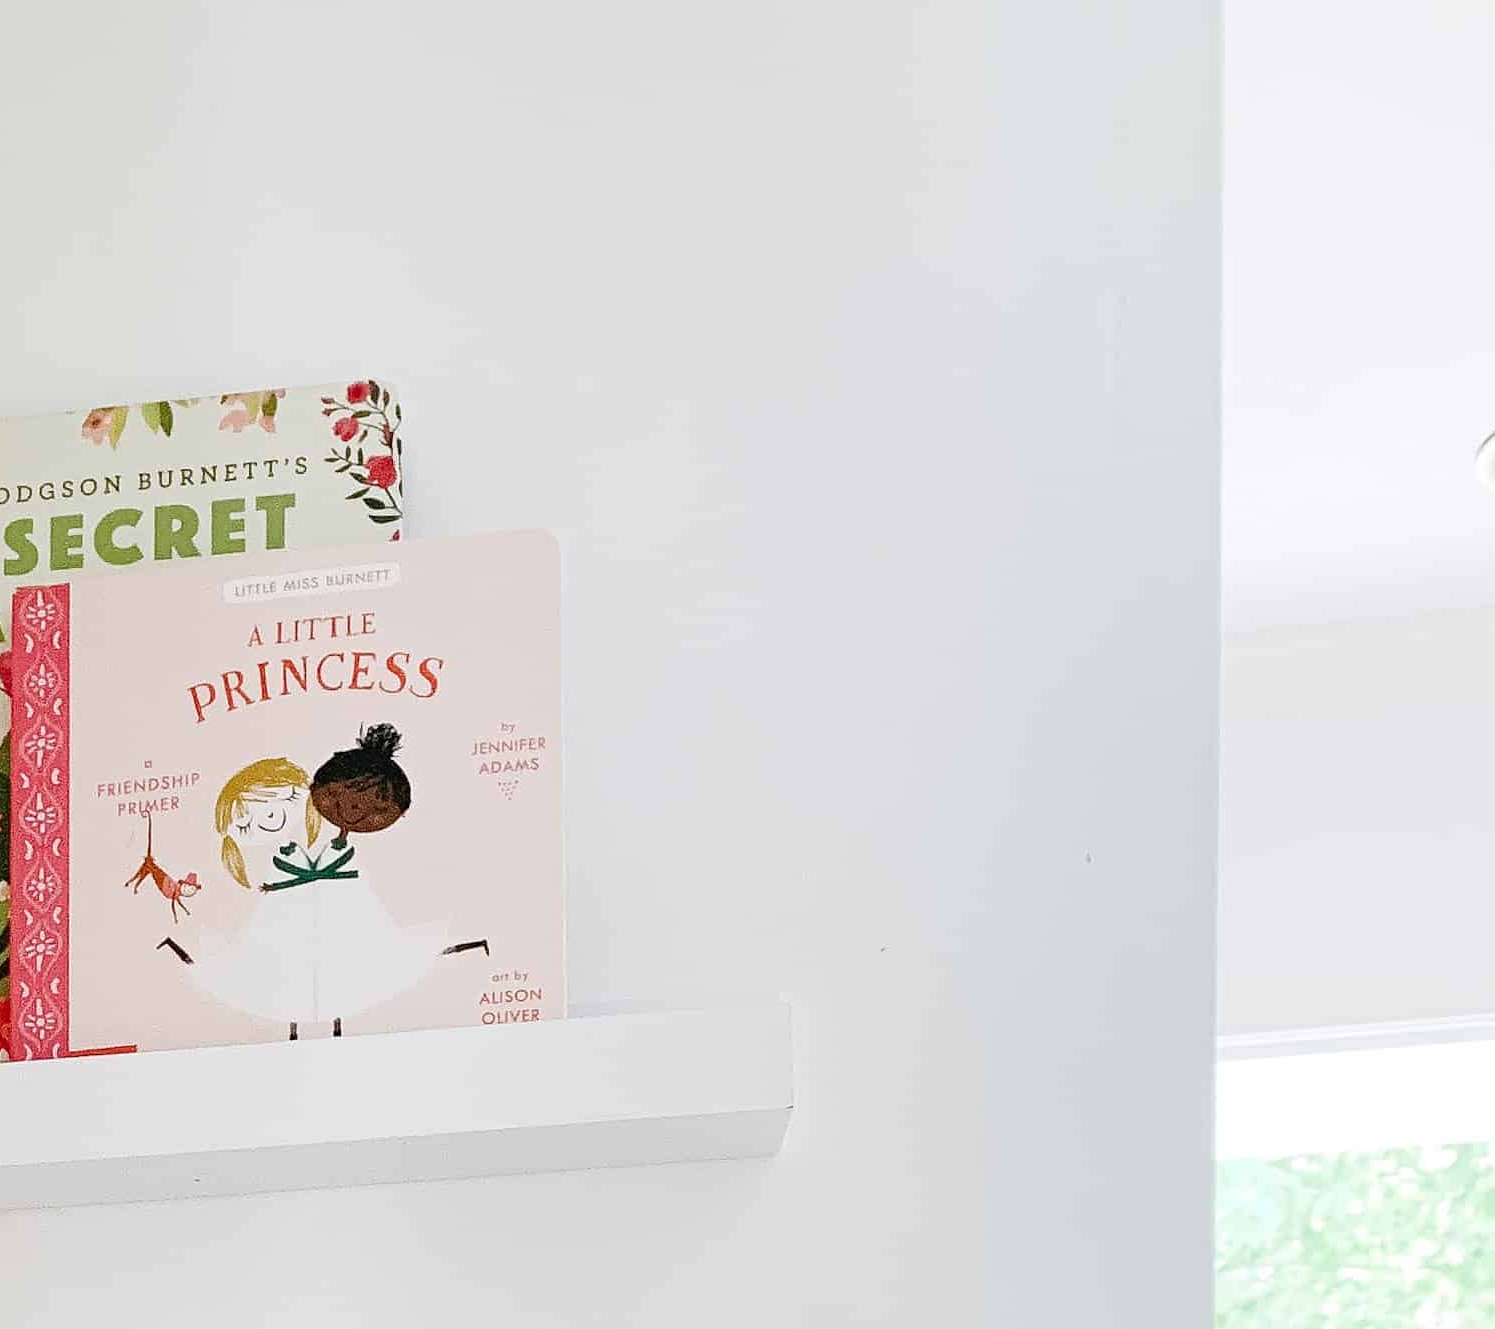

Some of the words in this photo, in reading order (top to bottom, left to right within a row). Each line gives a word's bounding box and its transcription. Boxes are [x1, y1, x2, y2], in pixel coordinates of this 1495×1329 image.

[138, 456, 308, 491] BURNETT'S
[3, 493, 296, 577] SECRET
[234, 582, 277, 597] LITTLE
[283, 578, 319, 592] MISS
[326, 569, 391, 587] BURNETT
[247, 626, 264, 647] A
[274, 612, 377, 645] LITTLE
[187, 651, 444, 723] PRINCESS
[501, 723, 515, 733] by
[472, 736, 546, 756] JENNIFER
[479, 758, 539, 774] ADAMS
[97, 772, 201, 798] FRIENDSHIP
[118, 796, 180, 817] PRIMER
[492, 973, 509, 982] art
[514, 970, 529, 983] by
[479, 987, 542, 1006] ALISON
[482, 1008, 540, 1025] OLIVER
